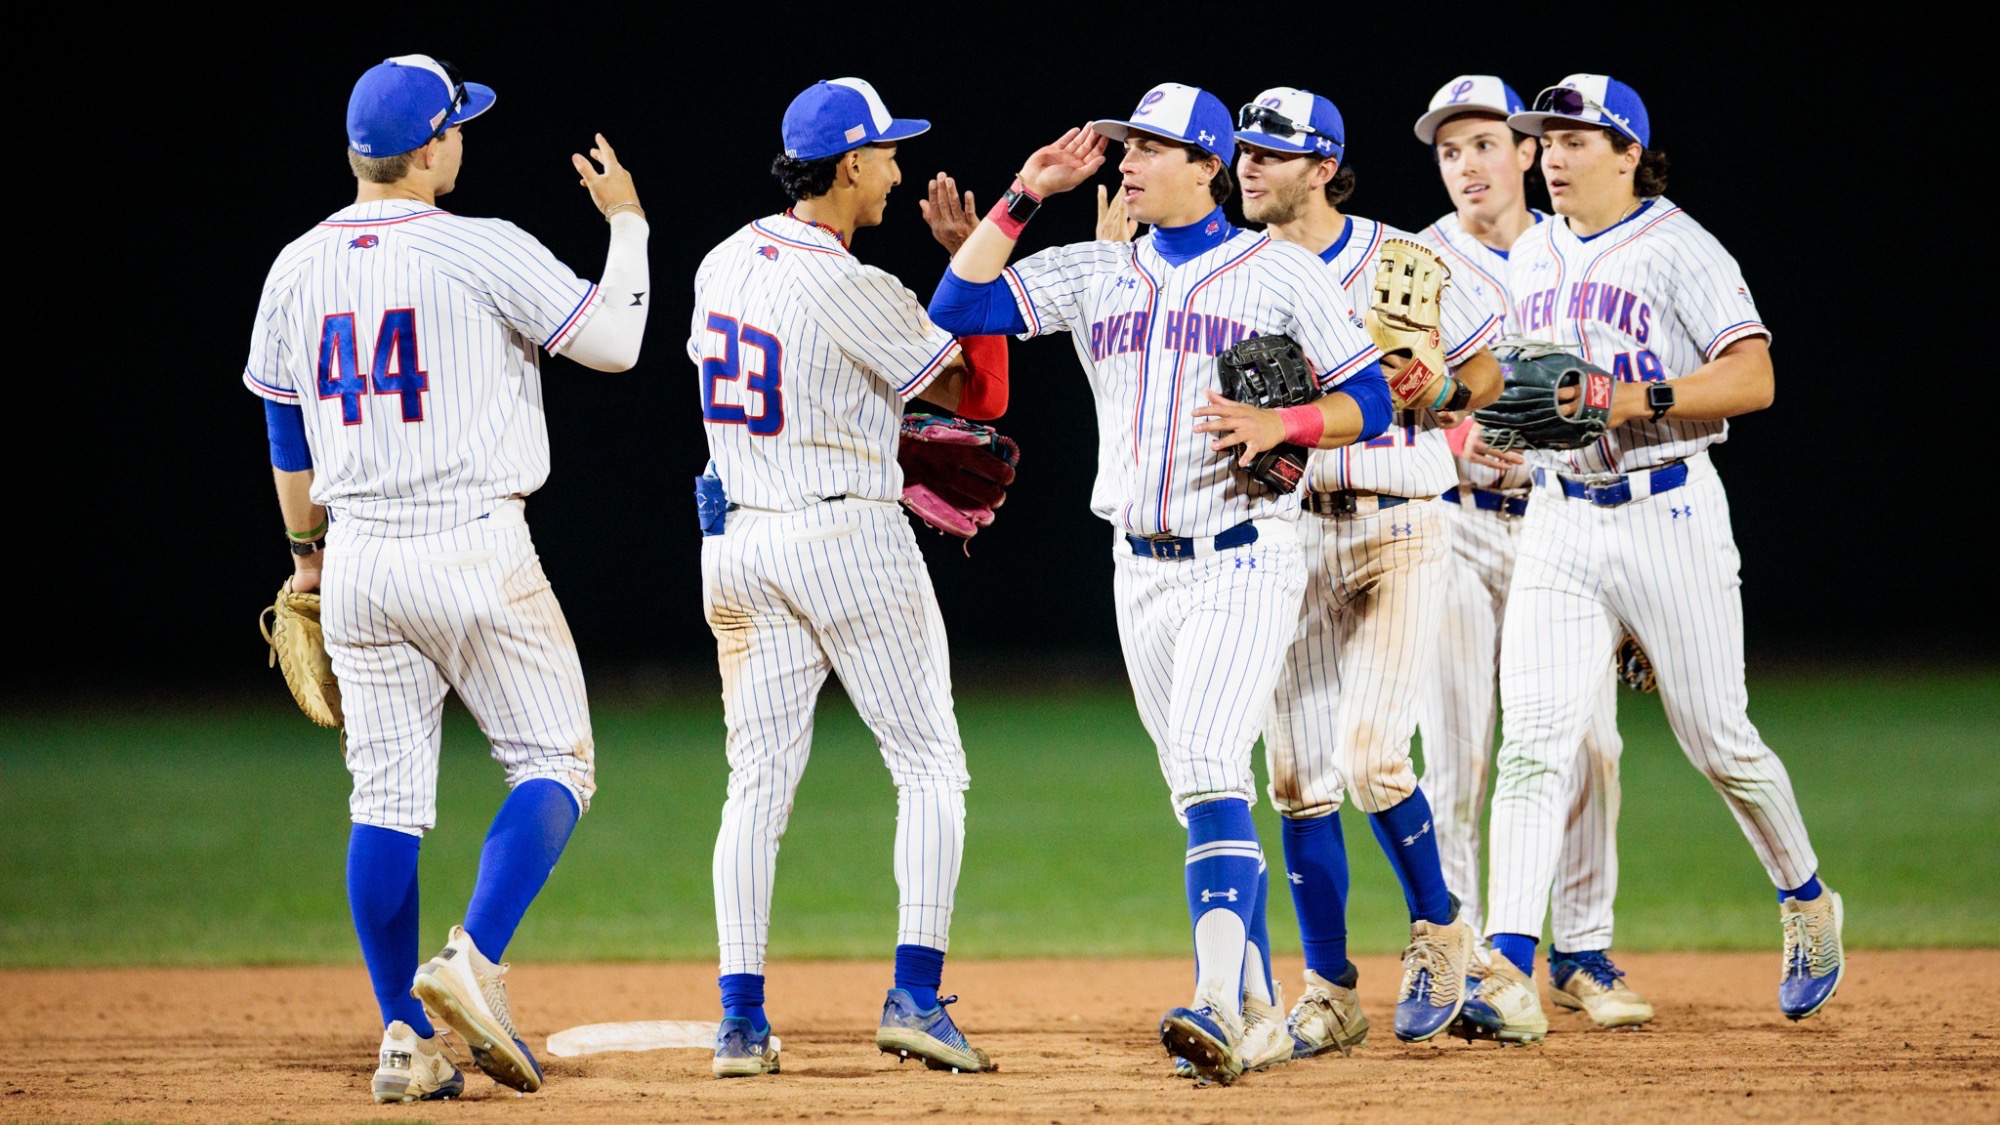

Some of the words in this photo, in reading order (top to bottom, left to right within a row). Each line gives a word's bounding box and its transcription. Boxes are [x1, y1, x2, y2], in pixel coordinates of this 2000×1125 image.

[1165, 310, 1260, 359] HAWK
[1567, 282, 1651, 344] HAWKS
[317, 308, 429, 426] 44
[702, 311, 785, 437] 23
